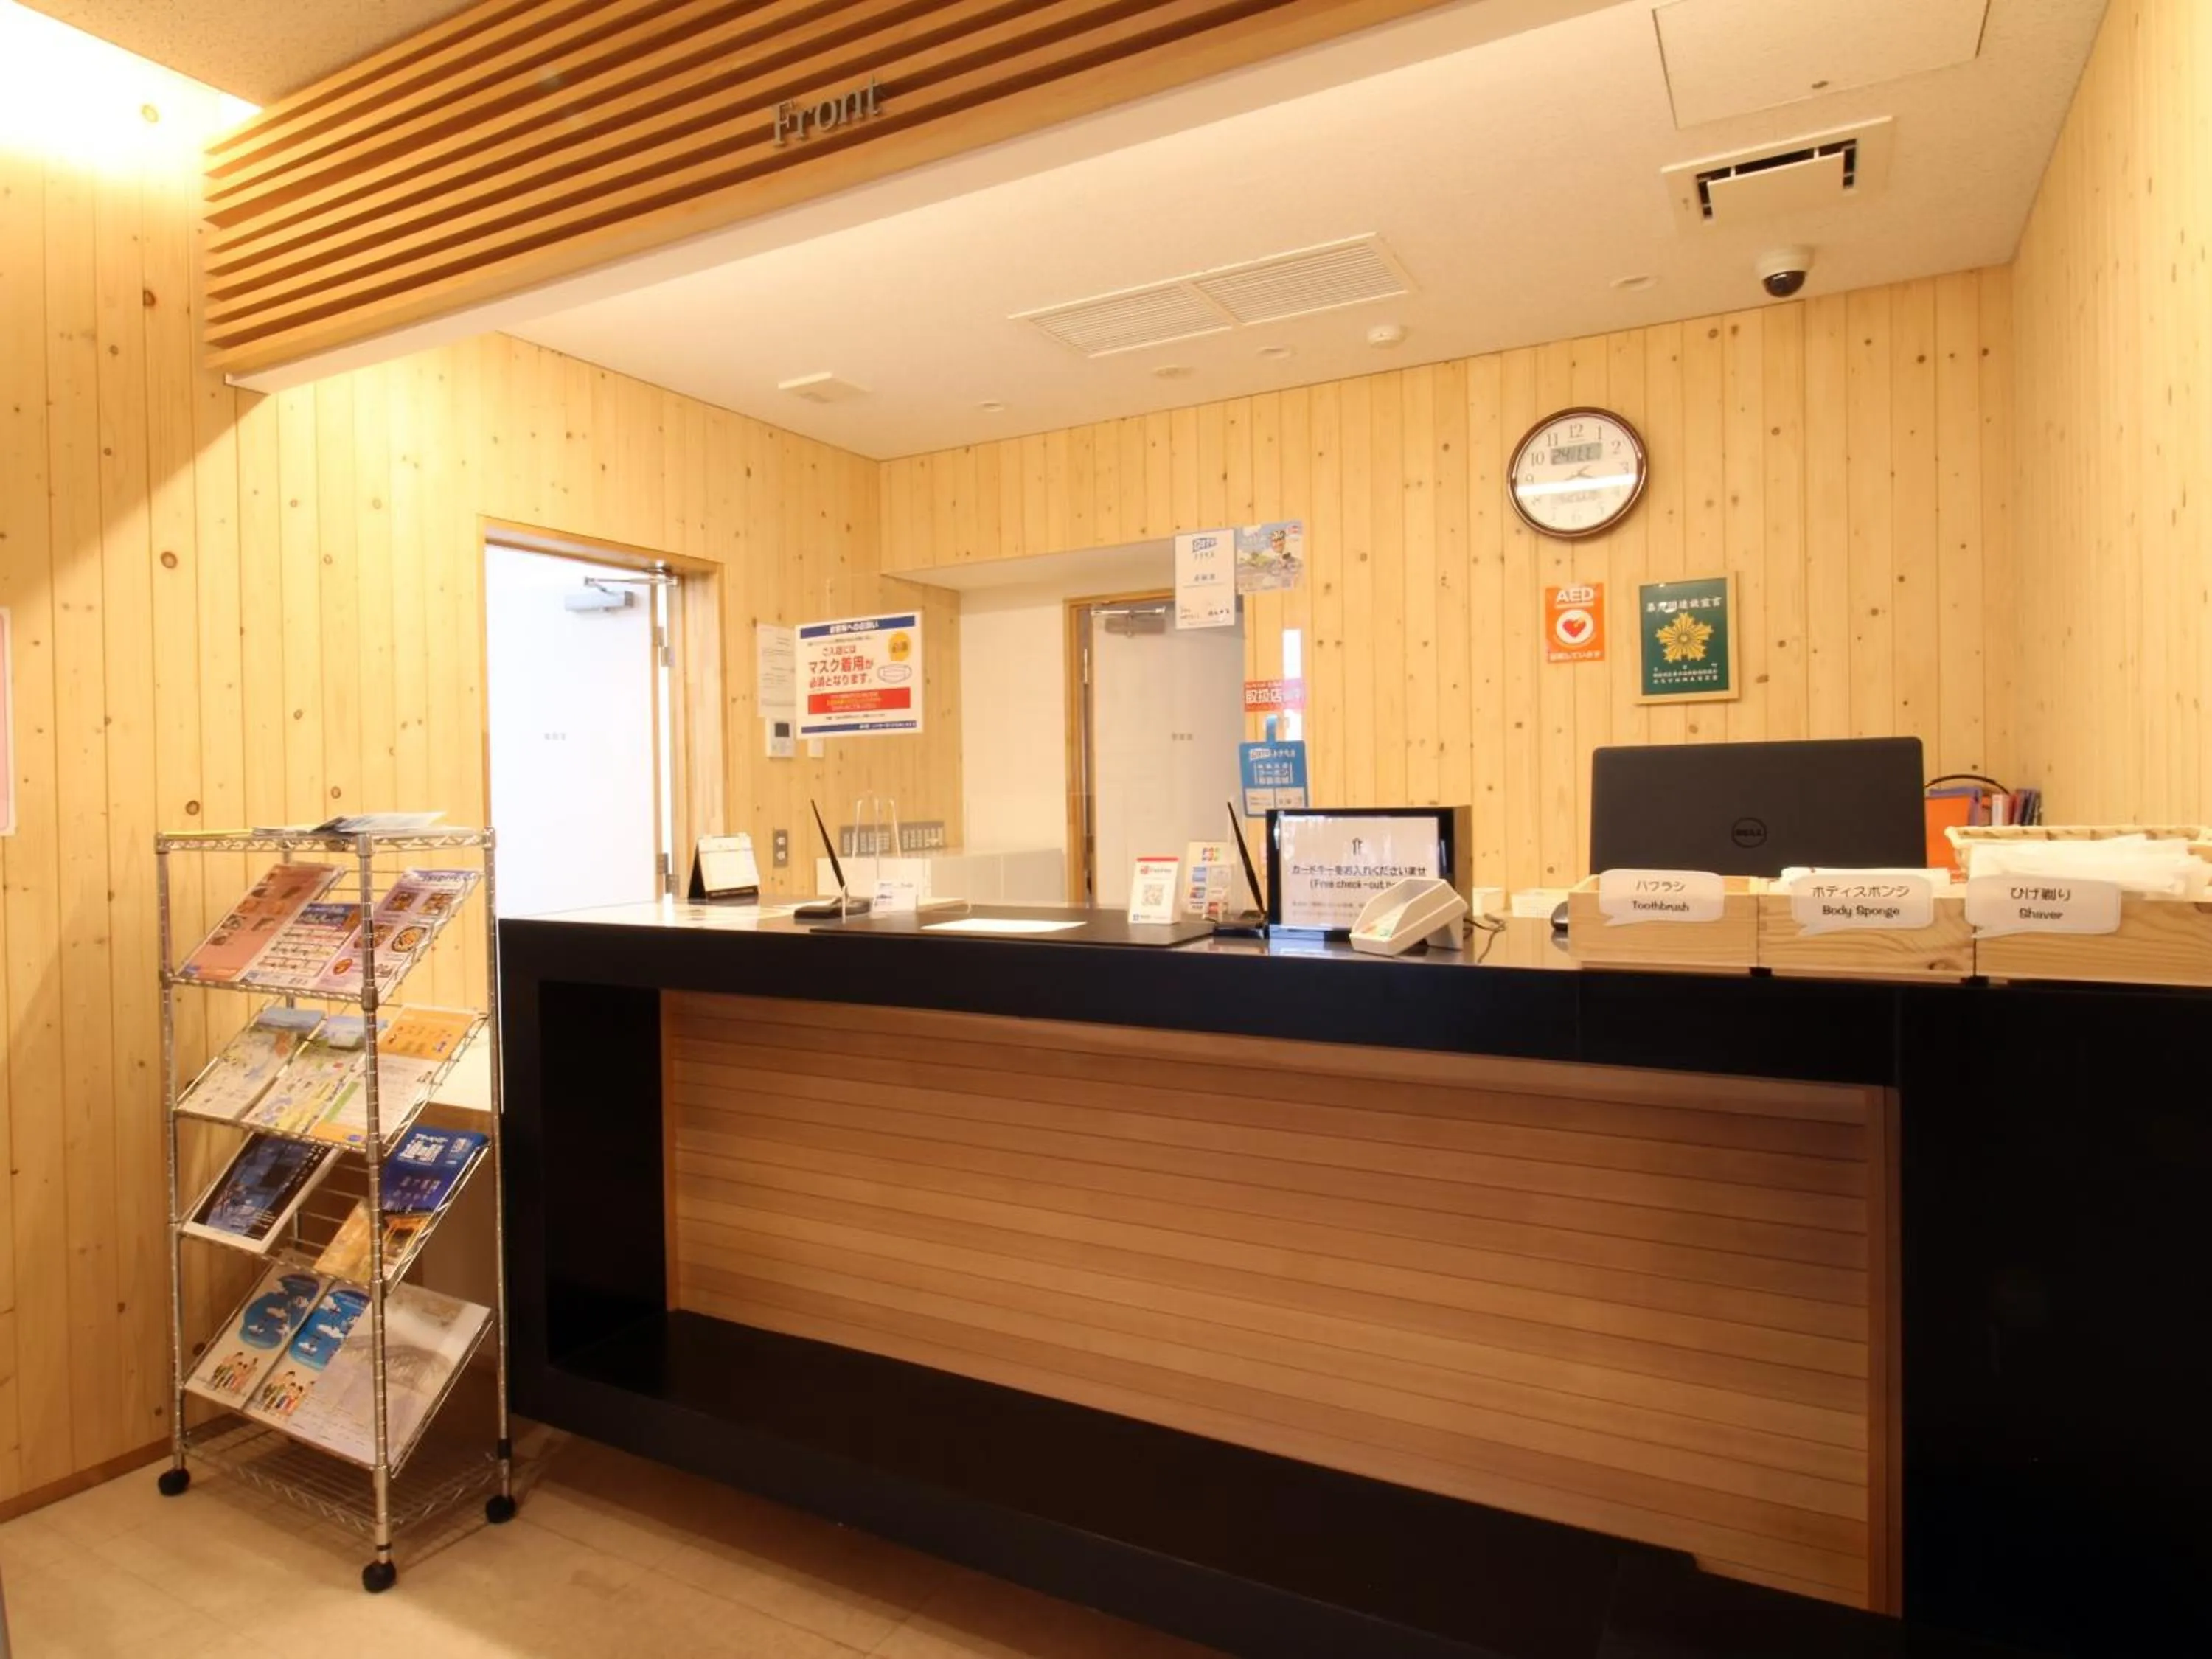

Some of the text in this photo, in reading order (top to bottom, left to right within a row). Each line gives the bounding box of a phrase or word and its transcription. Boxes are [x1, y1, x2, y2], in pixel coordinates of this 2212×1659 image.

[773, 75, 882, 145] Front
[1569, 423, 1585, 438] 12
[1531, 451, 1545, 467] 10
[1557, 587, 1594, 602] AED
[808, 655, 874, 673] マスク着用が
[1632, 900, 1690, 912] Toothbrush
[1822, 905, 1900, 918] Body Sponge
[2019, 908, 2063, 919] Shaver
